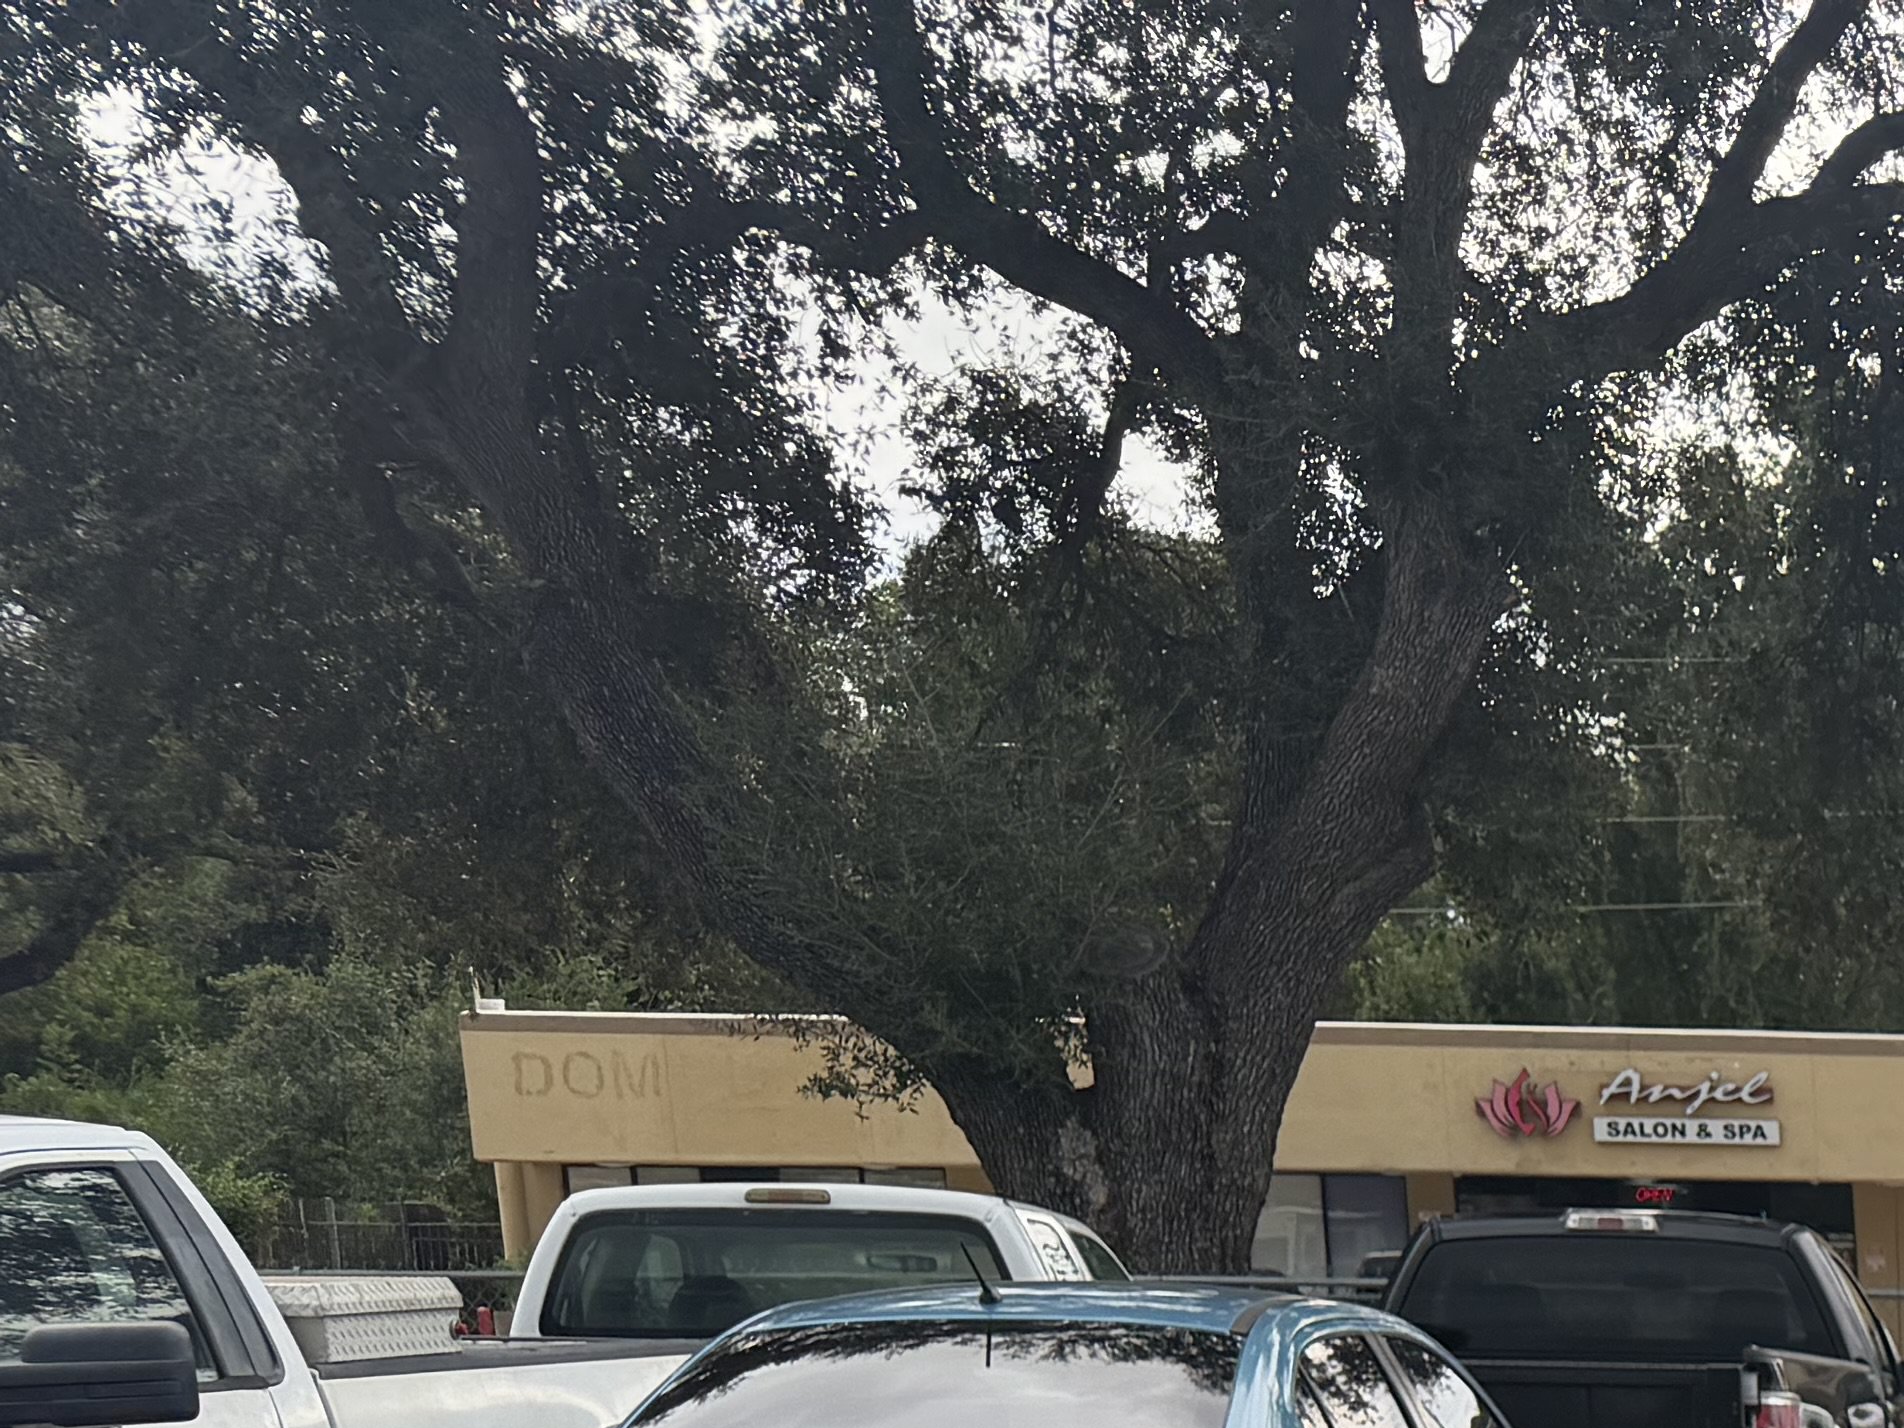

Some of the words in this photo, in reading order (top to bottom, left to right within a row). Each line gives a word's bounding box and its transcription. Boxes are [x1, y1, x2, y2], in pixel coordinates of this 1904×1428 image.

[1600, 1068, 1772, 1115] Anjel
[1606, 1121, 1687, 1138] SALON
[1696, 1123, 1713, 1139] &
[1723, 1123, 1767, 1140] SPA
